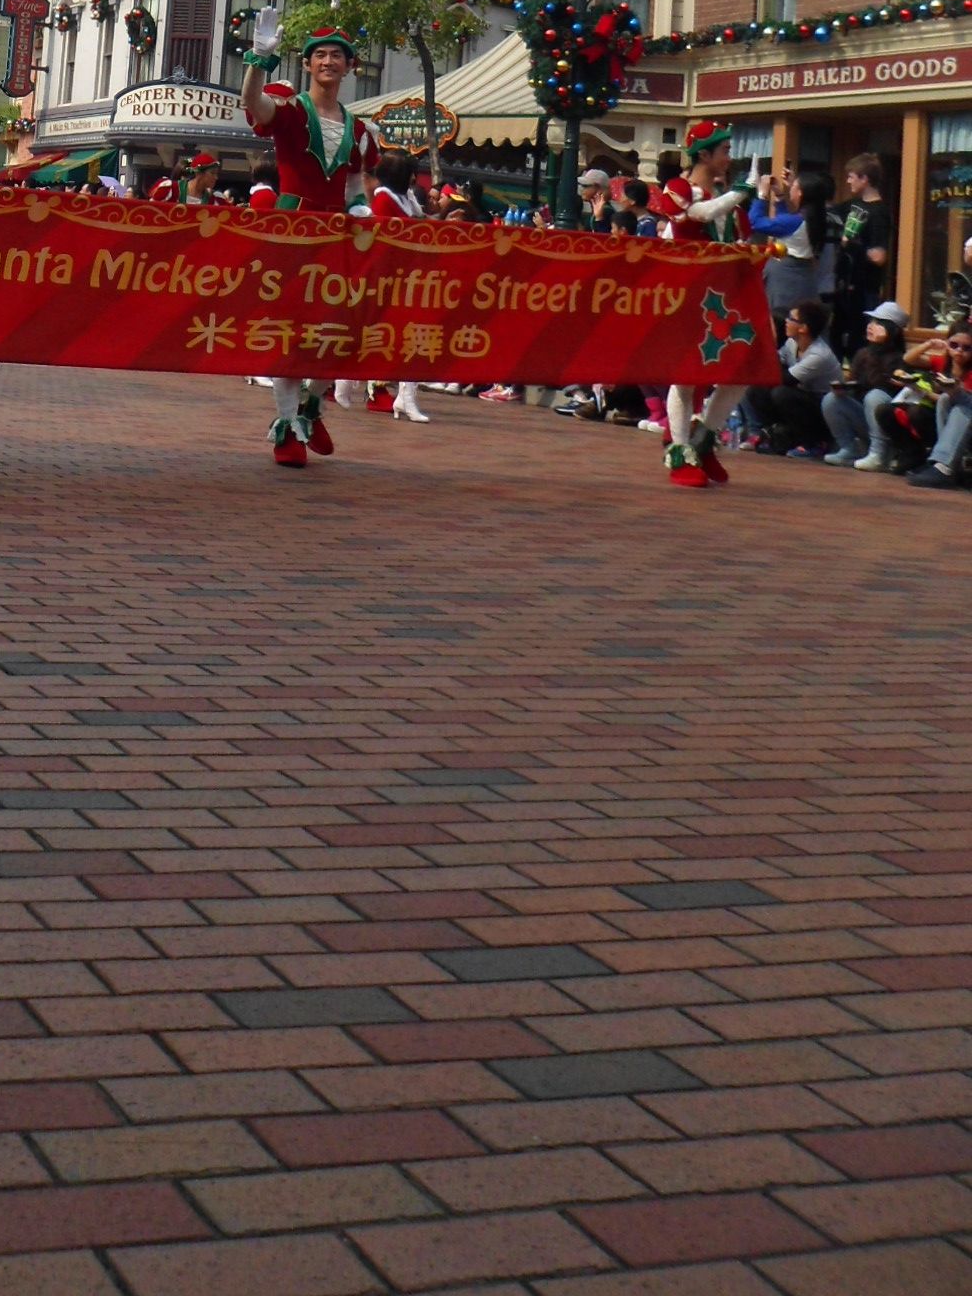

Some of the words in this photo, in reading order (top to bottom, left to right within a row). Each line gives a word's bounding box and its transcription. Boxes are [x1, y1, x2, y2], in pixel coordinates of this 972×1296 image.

[737, 71, 795, 92] FRESH
[802, 65, 867, 87] BAKED
[875, 57, 957, 81] GOODS
[120, 88, 176, 108] CENTER
[182, 88, 248, 110] STREE
[132, 103, 234, 121] BOUTIQUE
[298, 264, 462, 309] Toy-riffic
[472, 272, 582, 313] Street
[591, 278, 687, 316] Party
[185, 312, 491, 364] 米奇玩具舞曲
